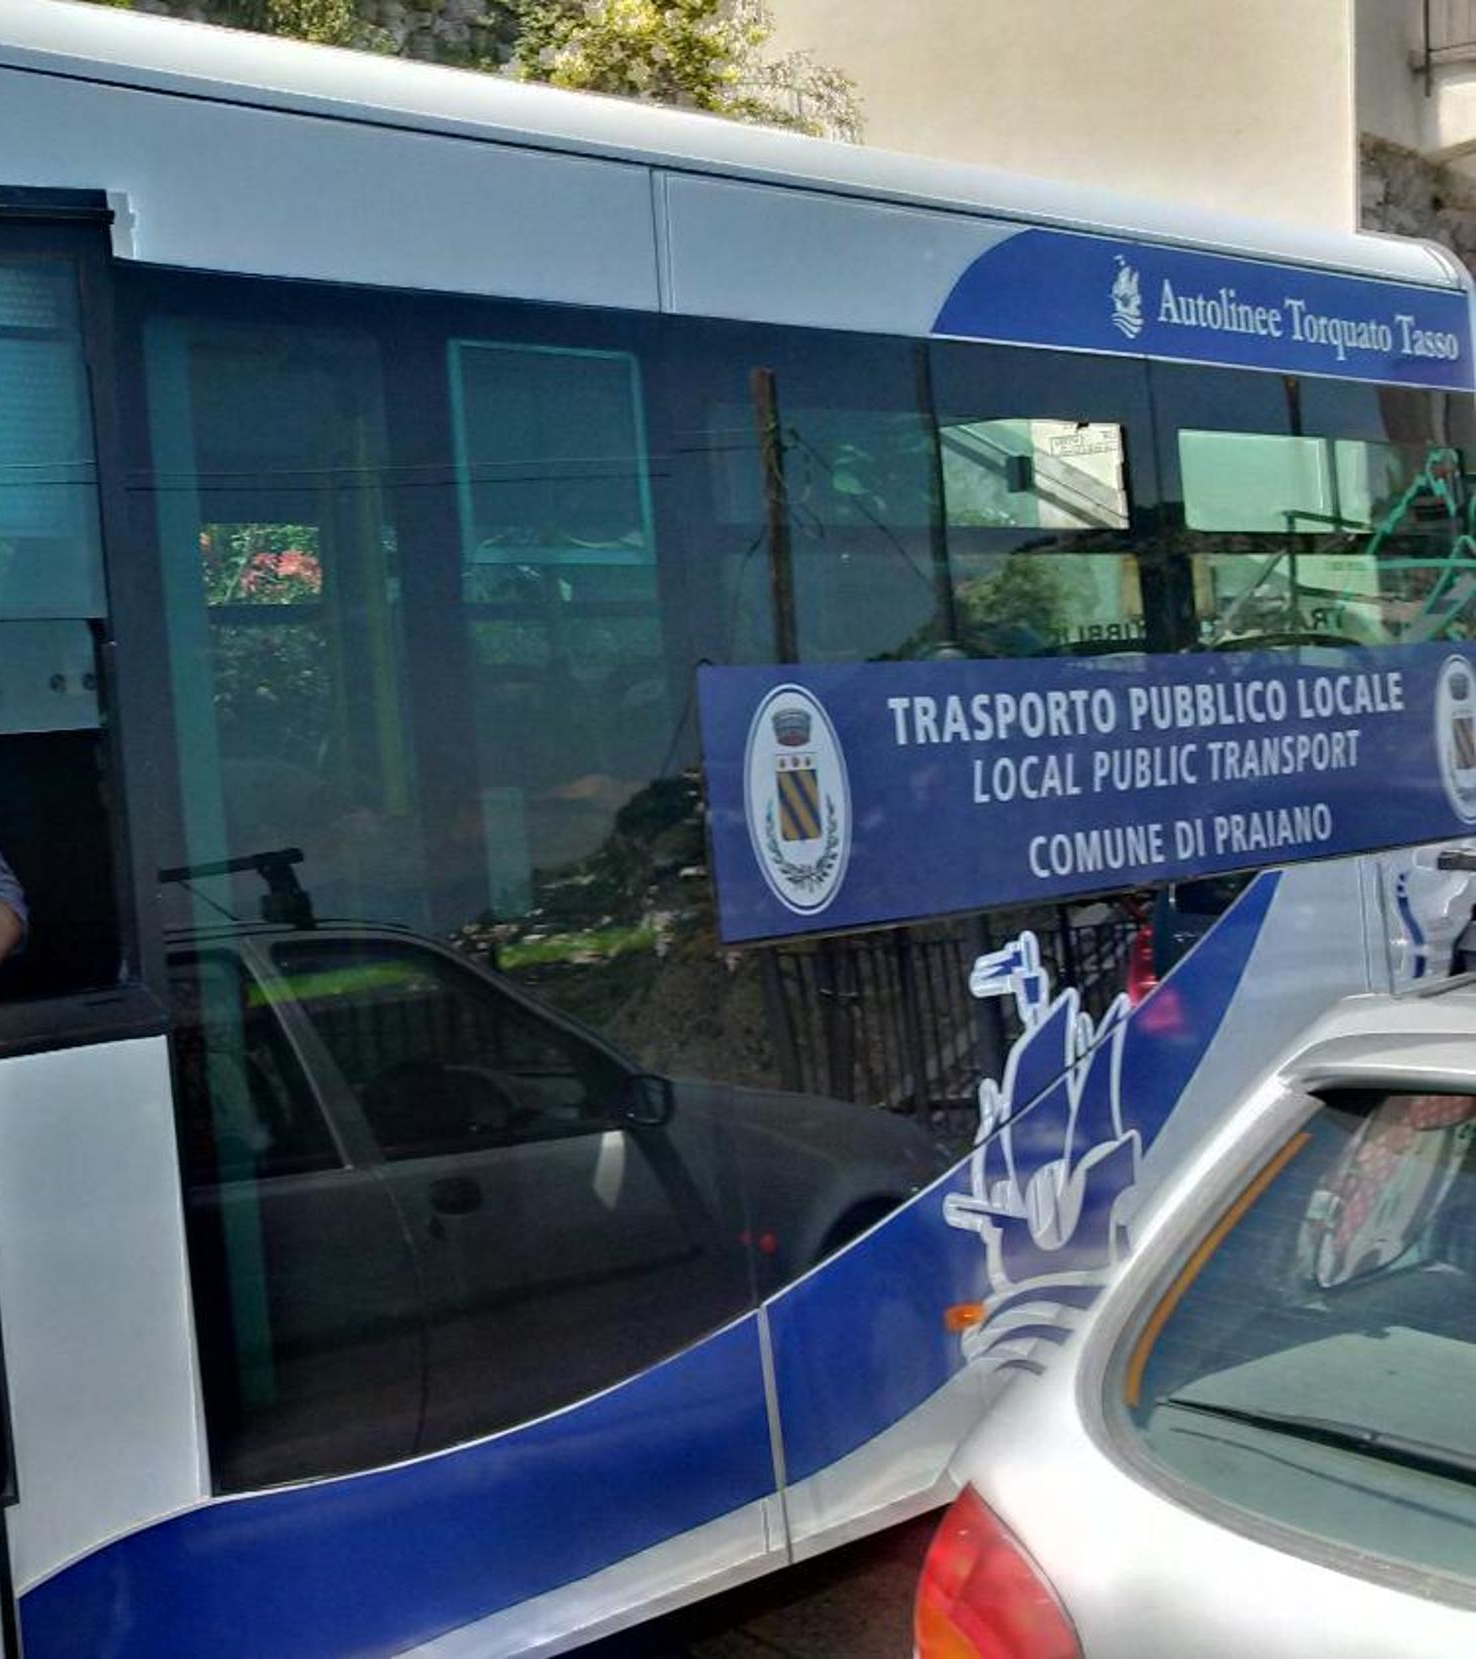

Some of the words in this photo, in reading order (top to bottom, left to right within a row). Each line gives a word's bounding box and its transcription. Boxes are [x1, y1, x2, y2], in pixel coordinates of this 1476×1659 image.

[1157, 279, 1281, 336] Autolinee
[1285, 299, 1391, 360] Torquato
[1395, 315, 1459, 360] Tasso
[887, 688, 1116, 744] TRASPORTO
[1128, 680, 1287, 731] PUBBLICO
[1297, 672, 1405, 719] LOCALE
[974, 753, 1081, 804] LOCAL
[1093, 743, 1197, 792] PUBLIC
[1207, 729, 1361, 782] TRANSPORT
[1028, 823, 1165, 878] COMUNE
[1175, 818, 1206, 861] DI
[1214, 803, 1333, 856] PRAIANO
